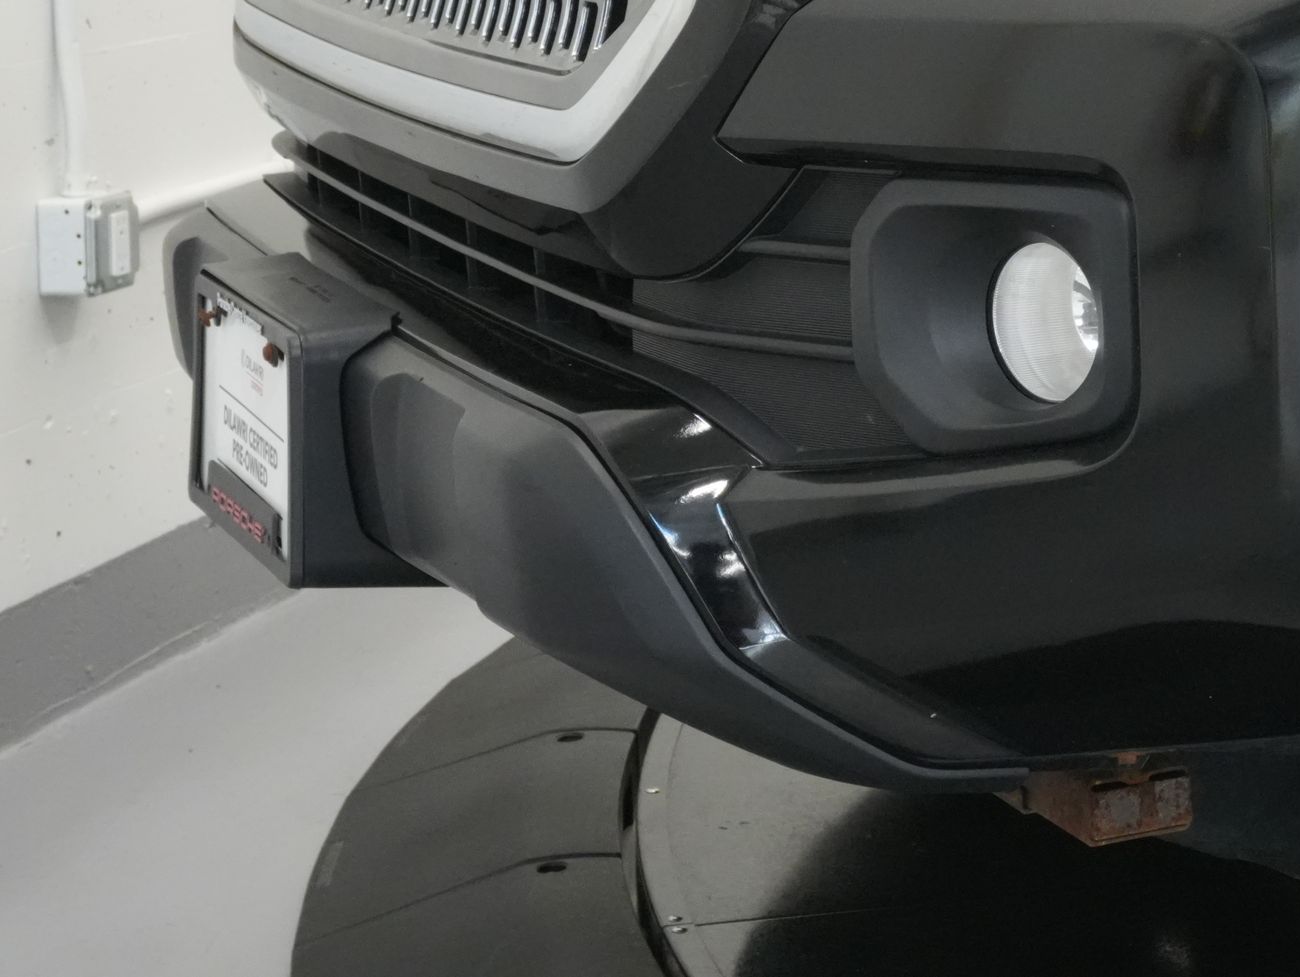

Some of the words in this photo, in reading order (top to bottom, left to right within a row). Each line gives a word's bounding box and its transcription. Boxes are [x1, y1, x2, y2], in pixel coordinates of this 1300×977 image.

[223, 404, 248, 443] DILAWRI
[249, 425, 278, 470] CERTIFIED
[232, 438, 268, 488] PRE-OWNED
[211, 486, 267, 544] PORSCHE
